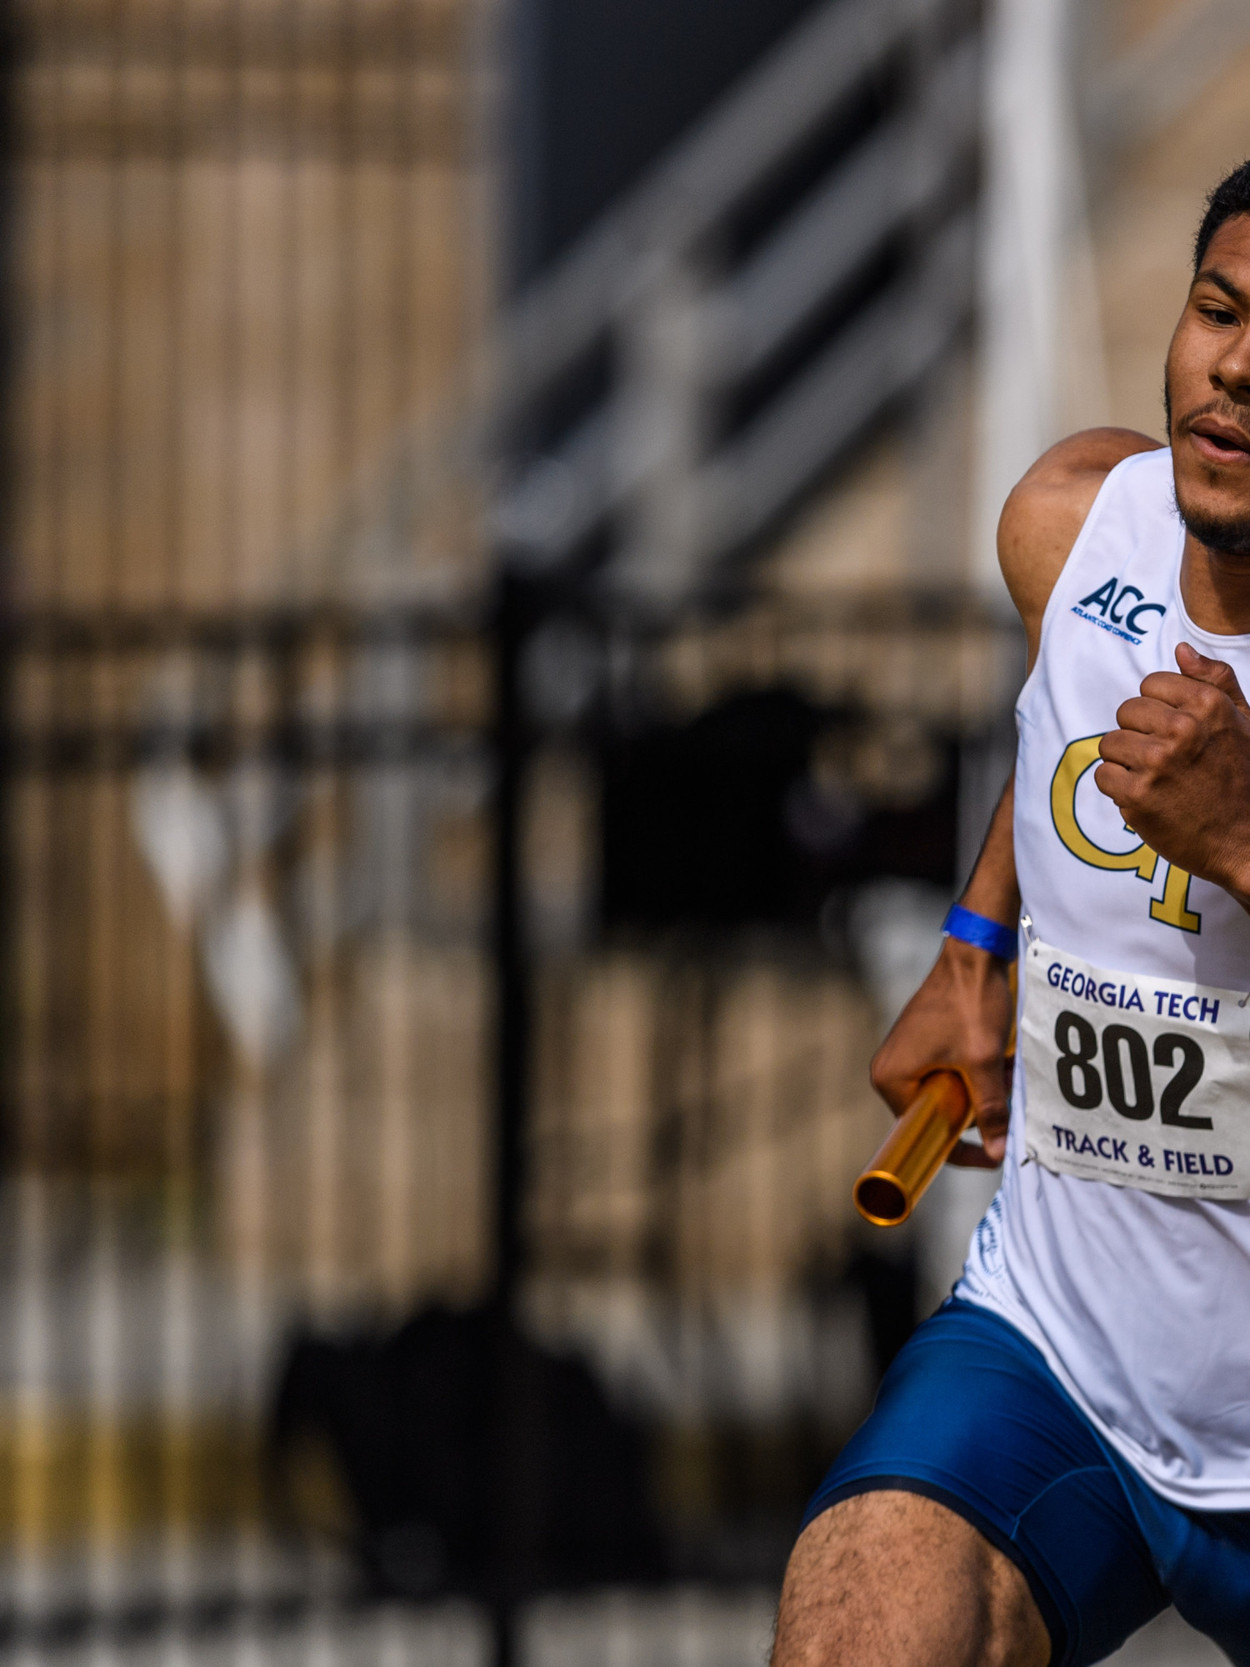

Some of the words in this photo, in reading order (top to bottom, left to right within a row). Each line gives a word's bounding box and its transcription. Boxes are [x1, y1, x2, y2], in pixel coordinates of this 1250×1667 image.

[1078, 576, 1167, 636] ACC
[1047, 962, 1145, 1012] GEORGIA
[1153, 990, 1220, 1024] TECH
[1054, 1009, 1214, 1131] 802
[1052, 1125, 1129, 1163] TRACK
[1138, 1144, 1155, 1169] &
[1164, 1149, 1234, 1176] FIELD
